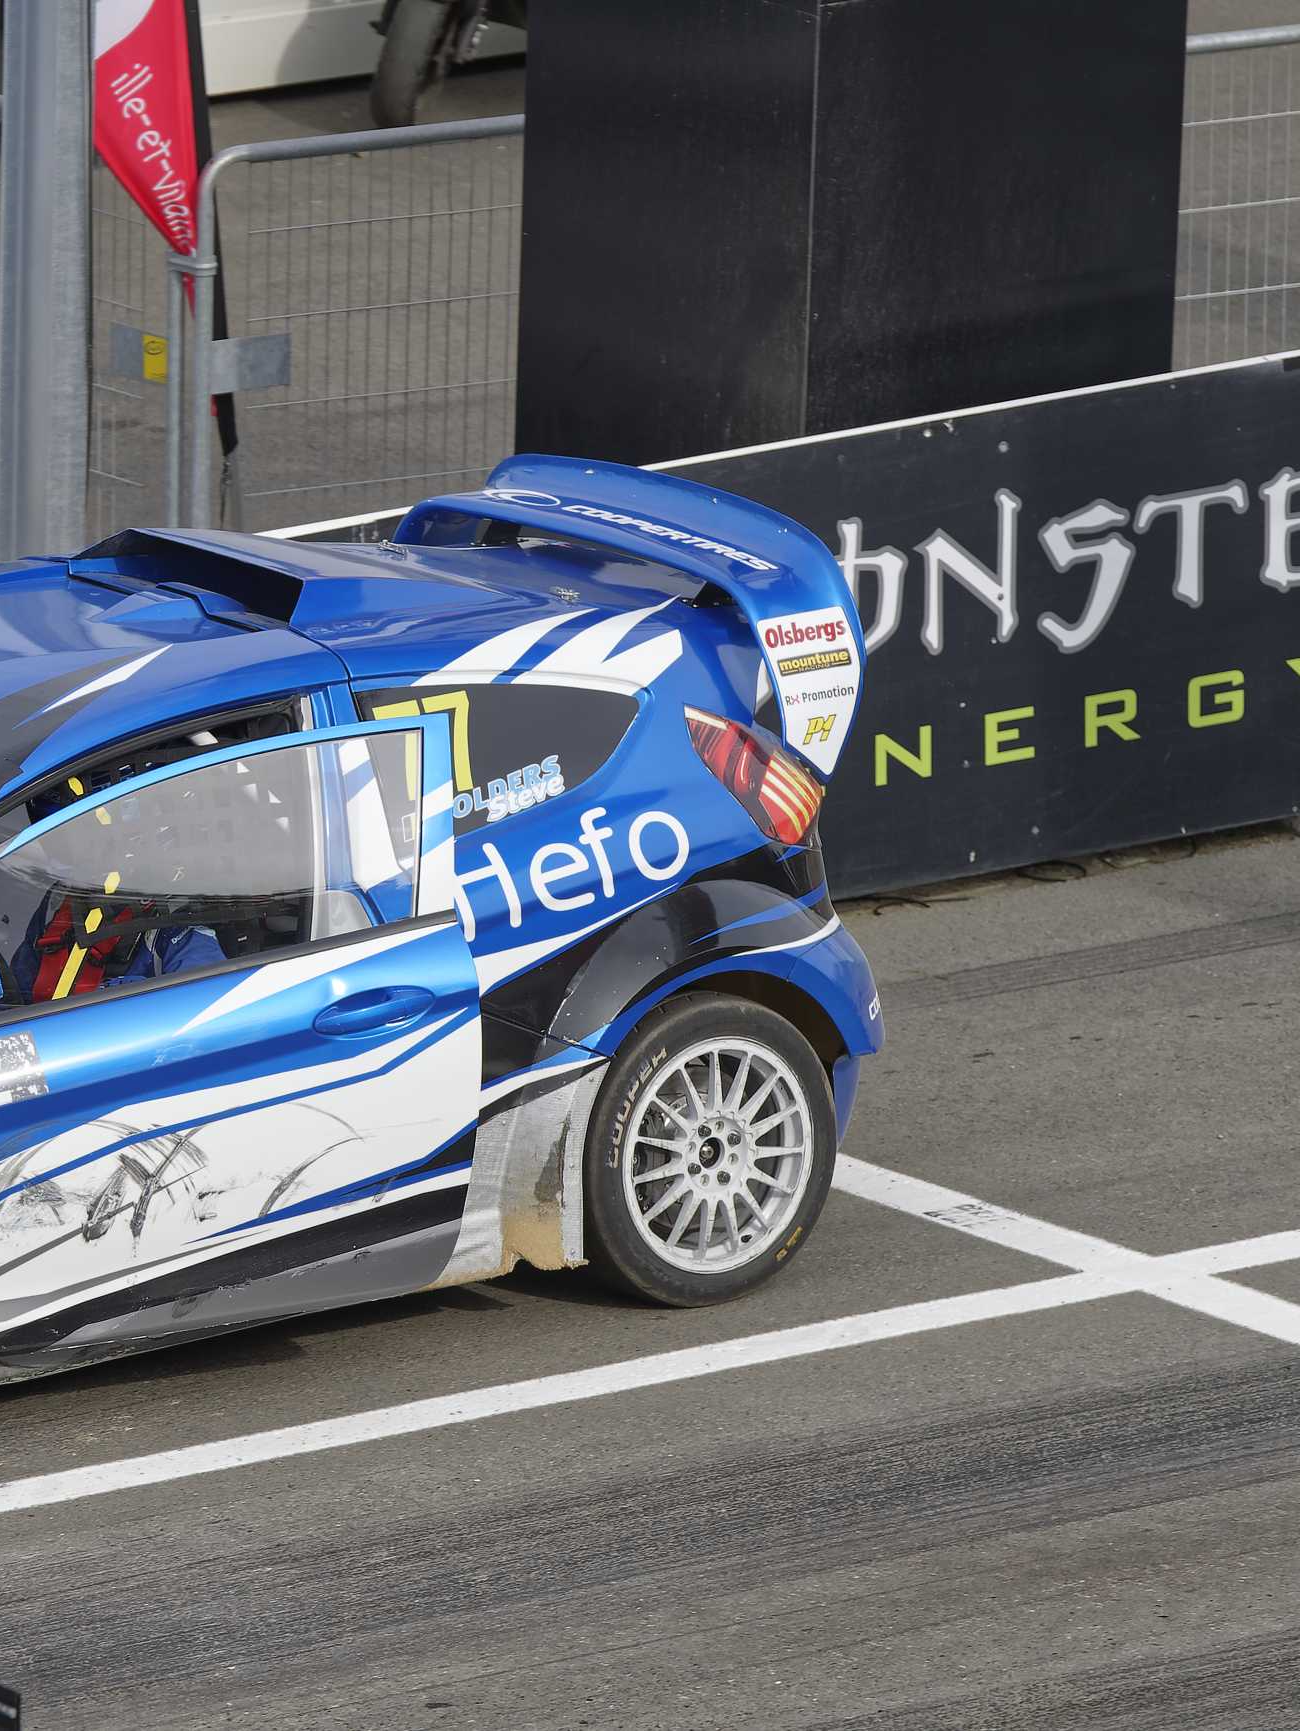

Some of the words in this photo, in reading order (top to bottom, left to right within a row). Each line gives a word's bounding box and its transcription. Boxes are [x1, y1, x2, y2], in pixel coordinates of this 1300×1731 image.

[765, 620, 846, 648] Olsbergs
[779, 651, 849, 673] mountune
[802, 684, 855, 703] Promotion
[875, 658, 1300, 787] NERG
[487, 775, 565, 822] Steve
[454, 807, 689, 942] Hefo
